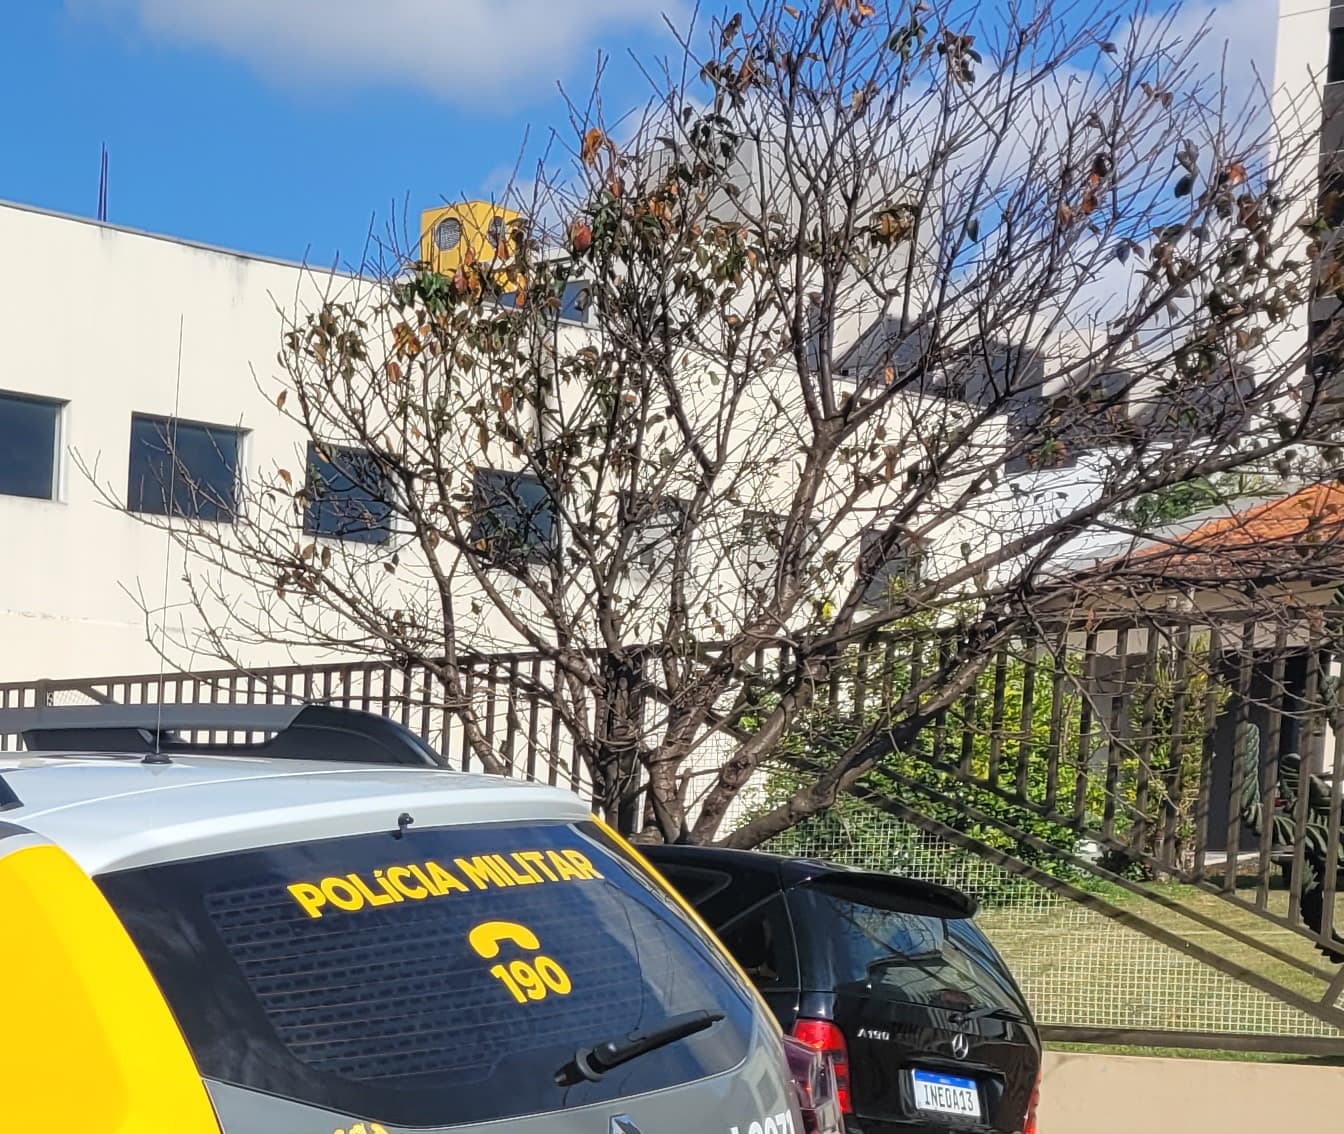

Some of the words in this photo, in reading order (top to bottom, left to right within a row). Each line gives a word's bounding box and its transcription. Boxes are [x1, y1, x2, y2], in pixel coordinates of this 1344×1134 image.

[286, 861, 470, 919] POLÍCIA
[454, 849, 605, 890] MILITAR
[490, 955, 572, 1004] 190
